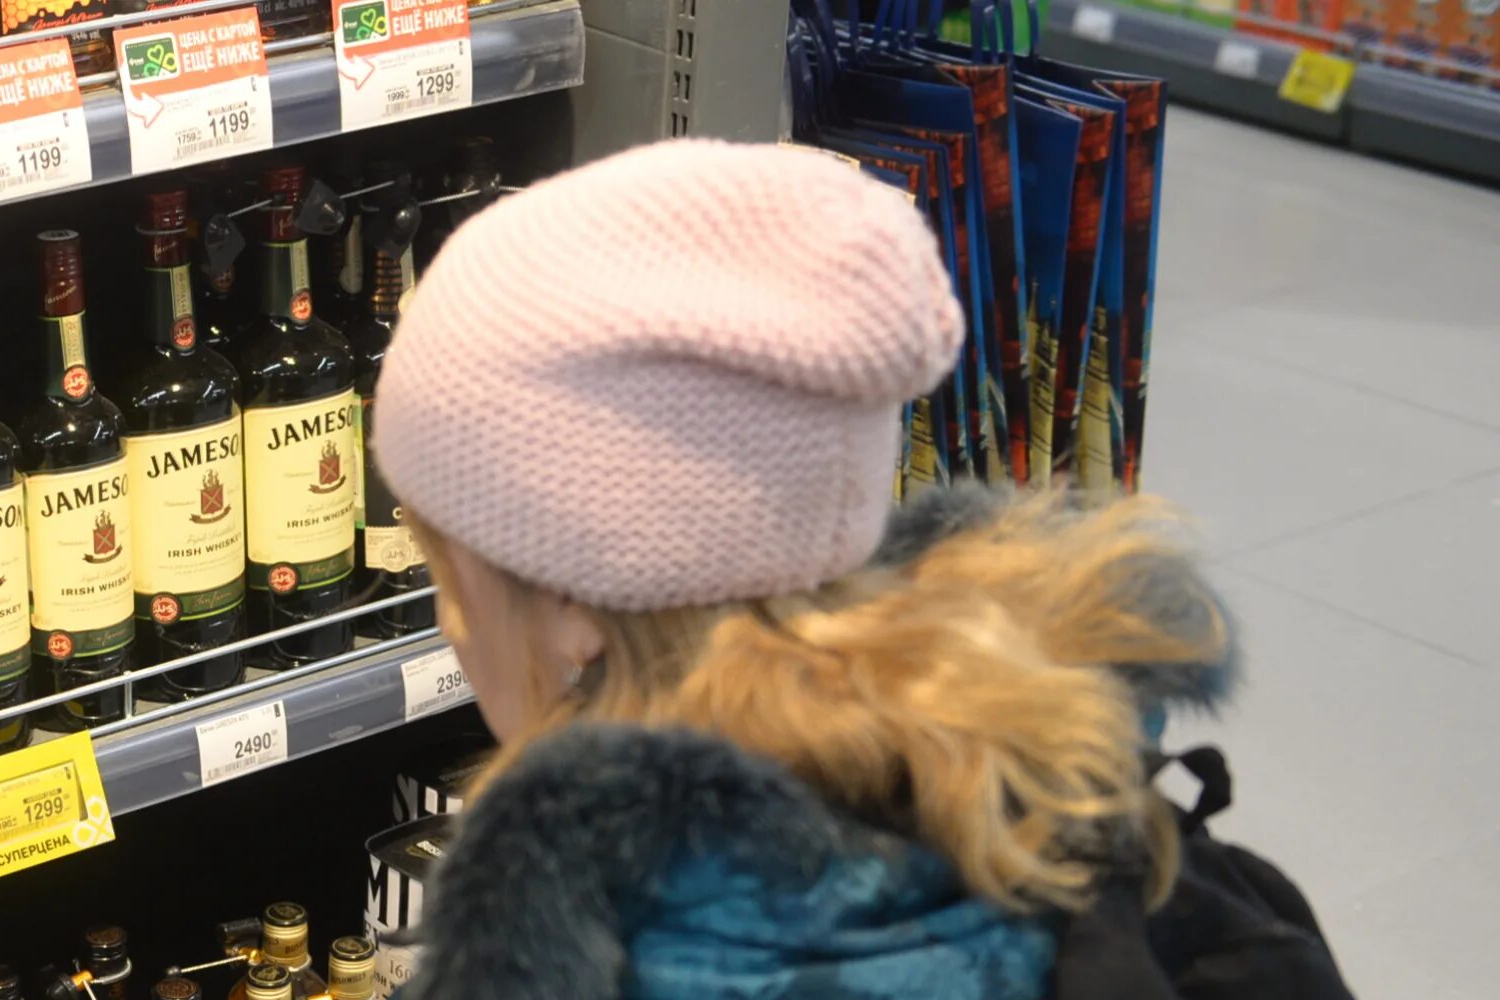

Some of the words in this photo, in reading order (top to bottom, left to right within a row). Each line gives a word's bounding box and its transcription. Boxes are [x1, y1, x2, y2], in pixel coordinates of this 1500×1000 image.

[179, 30, 210, 49] ЦЕНА
[209, 29, 217, 43] С
[216, 19, 258, 42] КАРТОЙ
[392, 10, 423, 36] ЕЩЁ
[423, 5, 466, 31] НИЖЕ
[18, 61, 27, 75] С
[27, 51, 69, 74] КАРТОЙ
[182, 46, 215, 73] ЕЩЁ
[217, 40, 261, 68] НИЖЕ
[26, 71, 75, 99] НИЖЕ
[416, 71, 454, 98] 1299
[177, 132, 197, 145] 1759
[209, 110, 249, 138] 1199
[18, 146, 62, 174] 1199
[267, 403, 353, 451] JAMESO
[147, 433, 239, 478] JAMESO
[40, 473, 129, 518] JAMESO
[286, 518, 320, 529] IRISH
[167, 548, 203, 559] IRISH
[61, 587, 95, 597] IRISH
[234, 731, 272, 760] 2490
[24, 796, 64, 824] 1299
[389, 959, 412, 980] 160
